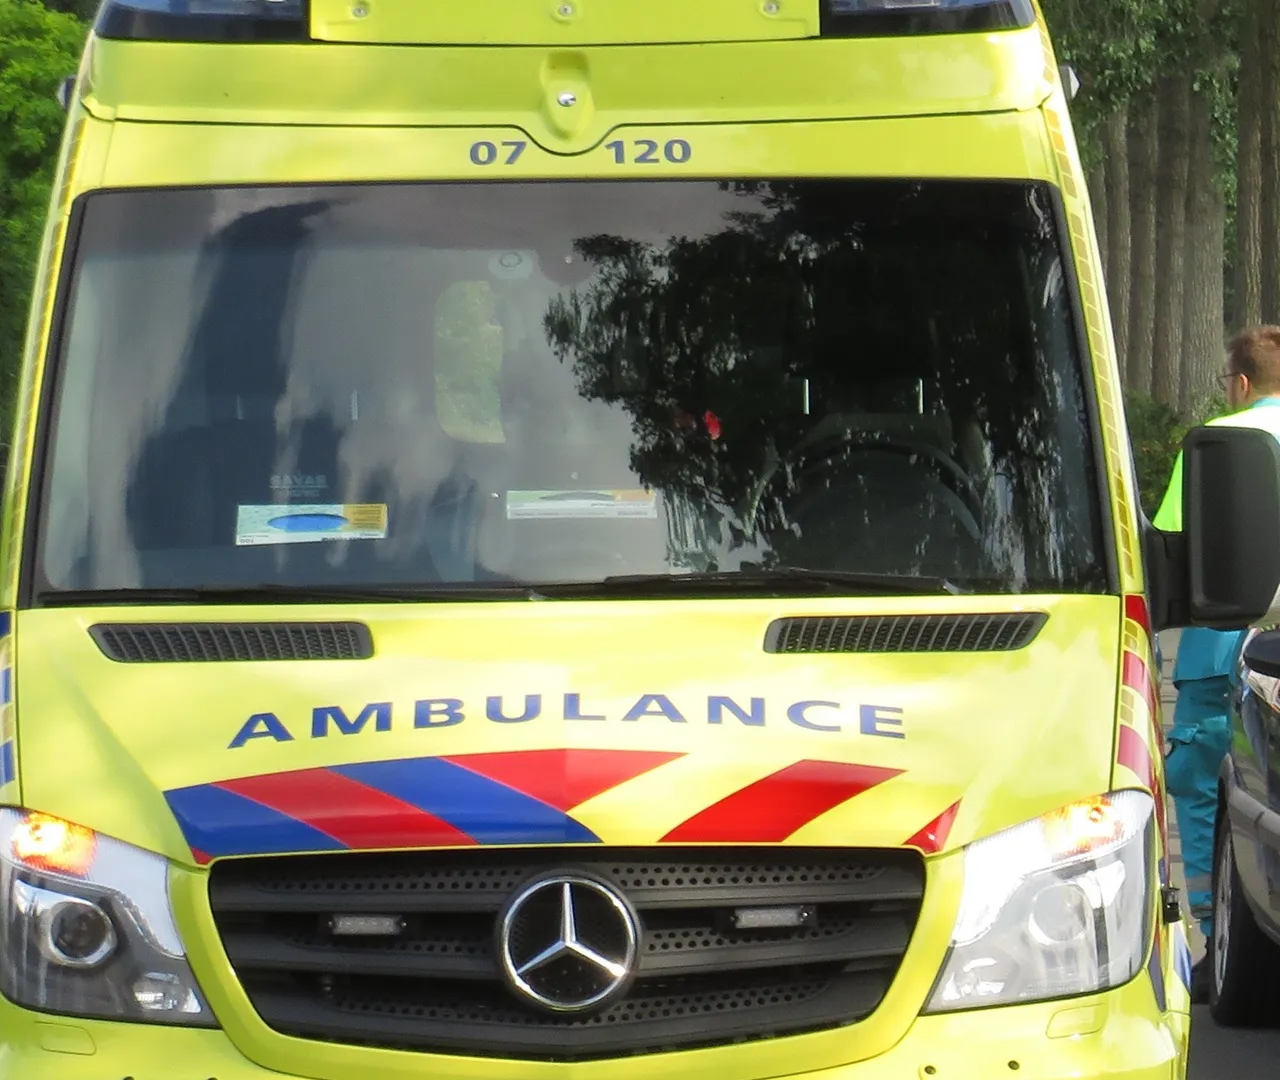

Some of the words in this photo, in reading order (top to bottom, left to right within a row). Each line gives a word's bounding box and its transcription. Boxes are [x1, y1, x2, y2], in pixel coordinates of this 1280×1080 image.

[469, 141, 527, 165] 07
[604, 139, 691, 164] 120
[227, 692, 906, 749] AMBULANCE
